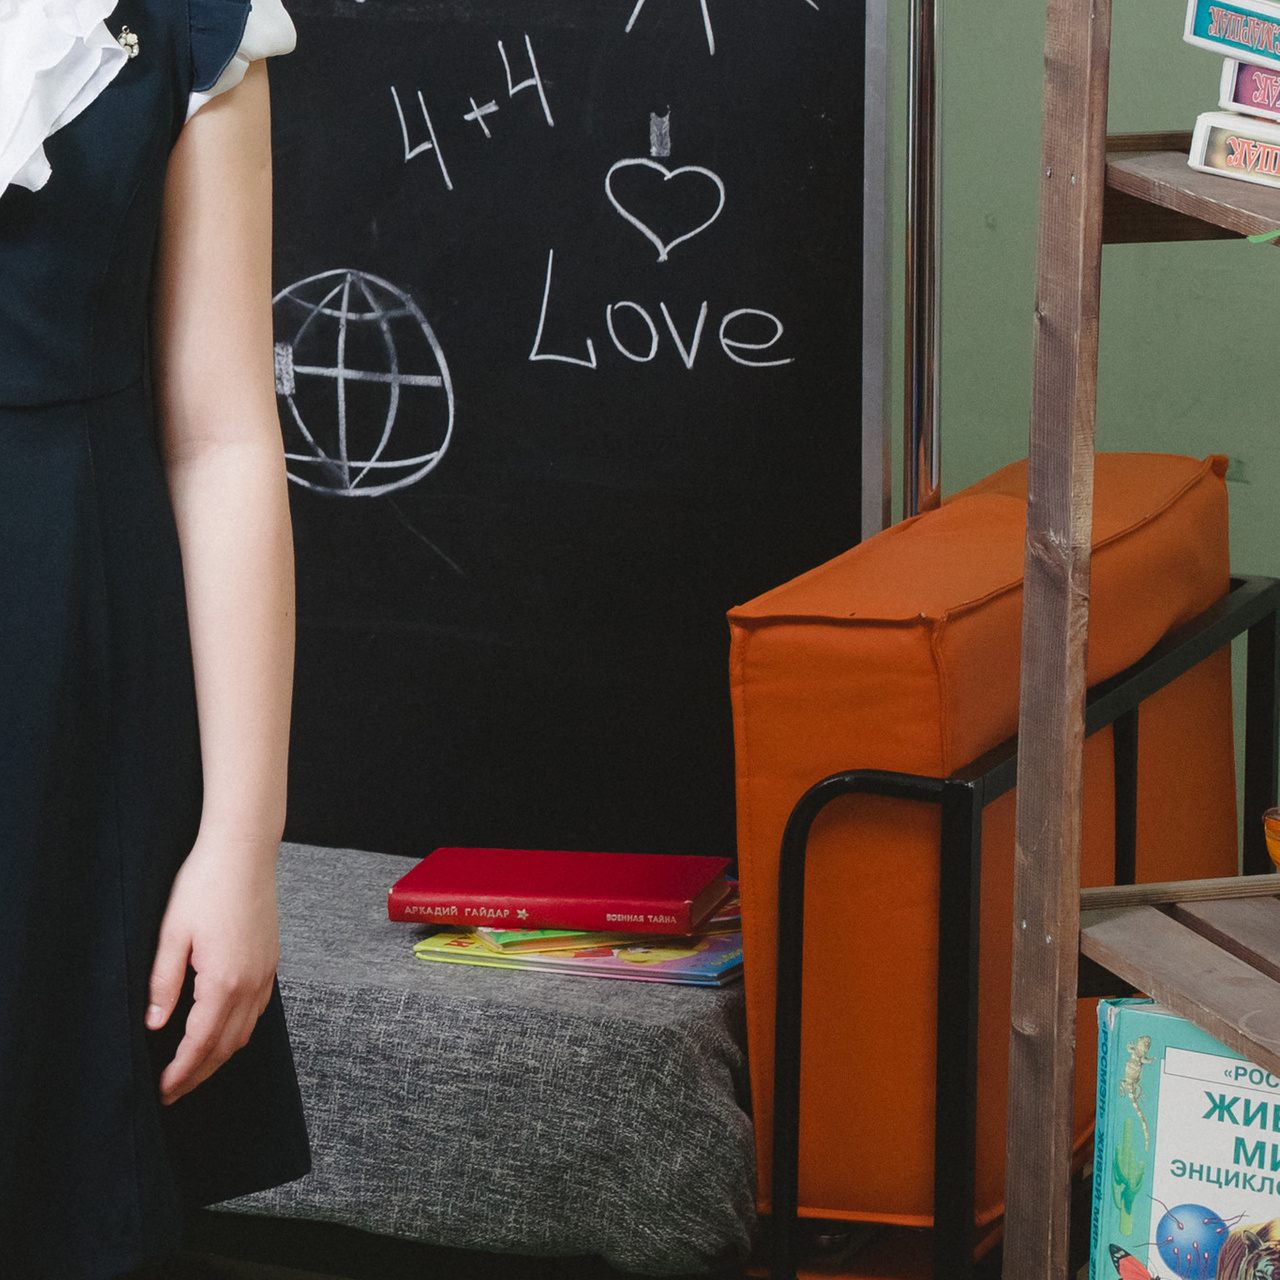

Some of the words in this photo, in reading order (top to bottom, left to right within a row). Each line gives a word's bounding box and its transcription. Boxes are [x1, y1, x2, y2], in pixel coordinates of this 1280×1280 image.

[528, 248, 796, 371] Love
[404, 905, 459, 916] АРКАДИЙ
[464, 906, 510, 918] ГАЙДАР
[606, 913, 645, 923] ВОЕННАЯ
[647, 915, 677, 924] ТАЙНА
[1099, 1020, 1109, 1119] «РОСМЭН»
[1094, 1127, 1105, 1201] ЖИВОЙ
[1170, 1158, 1280, 1196] ЭНЦИКЛ
[1091, 1205, 1101, 1250] МИР
